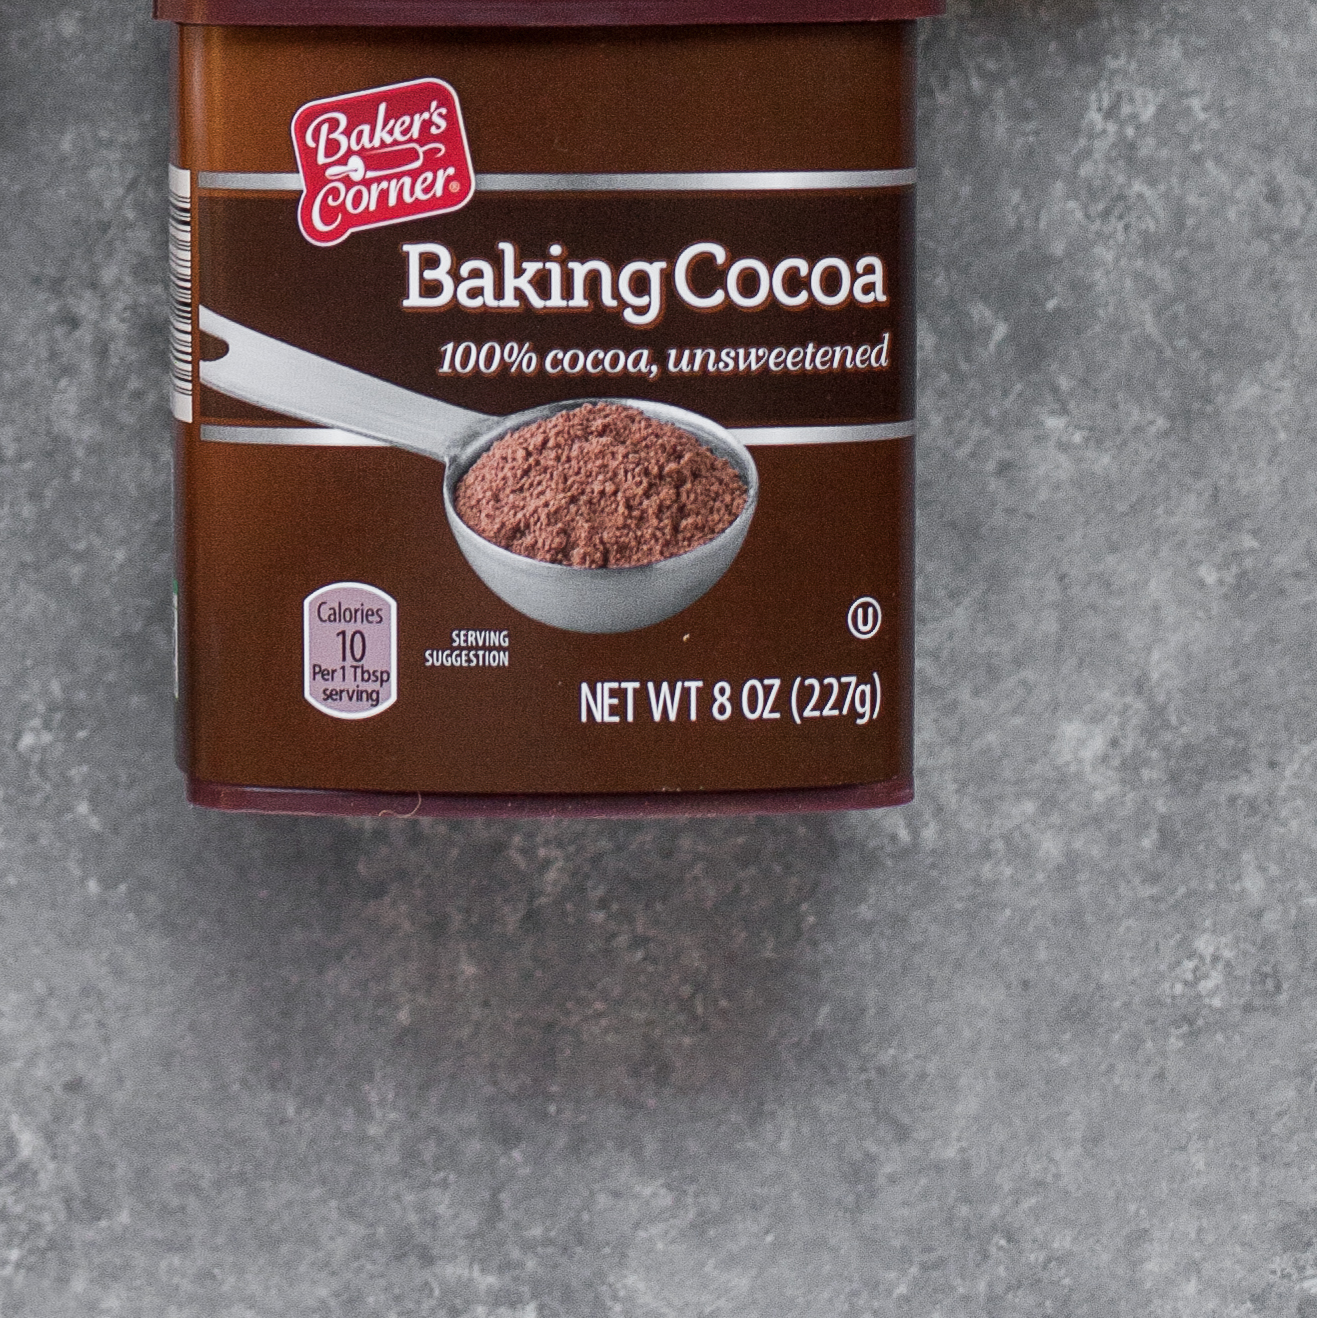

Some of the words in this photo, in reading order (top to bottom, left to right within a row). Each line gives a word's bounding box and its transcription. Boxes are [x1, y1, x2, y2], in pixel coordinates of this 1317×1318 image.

[305, 99, 448, 164] Baker's
[310, 163, 455, 233] Corner
[401, 242, 667, 326] Baking
[675, 242, 889, 310] Cocoa
[437, 340, 537, 375] 100%
[544, 345, 658, 381] cocoa,
[666, 332, 890, 373] unsweetened
[316, 600, 384, 627] Calories
[336, 630, 366, 664] 10
[451, 629, 510, 647] SERVING
[424, 649, 510, 667] SUGGESTION
[311, 665, 340, 684] Per
[351, 664, 391, 688] Tbsp
[321, 684, 381, 707] serving
[580, 681, 641, 724] NET
[648, 680, 703, 723] WT
[711, 680, 731, 721] 8
[741, 677, 781, 721] OZ
[790, 671, 883, 725] (227g)
